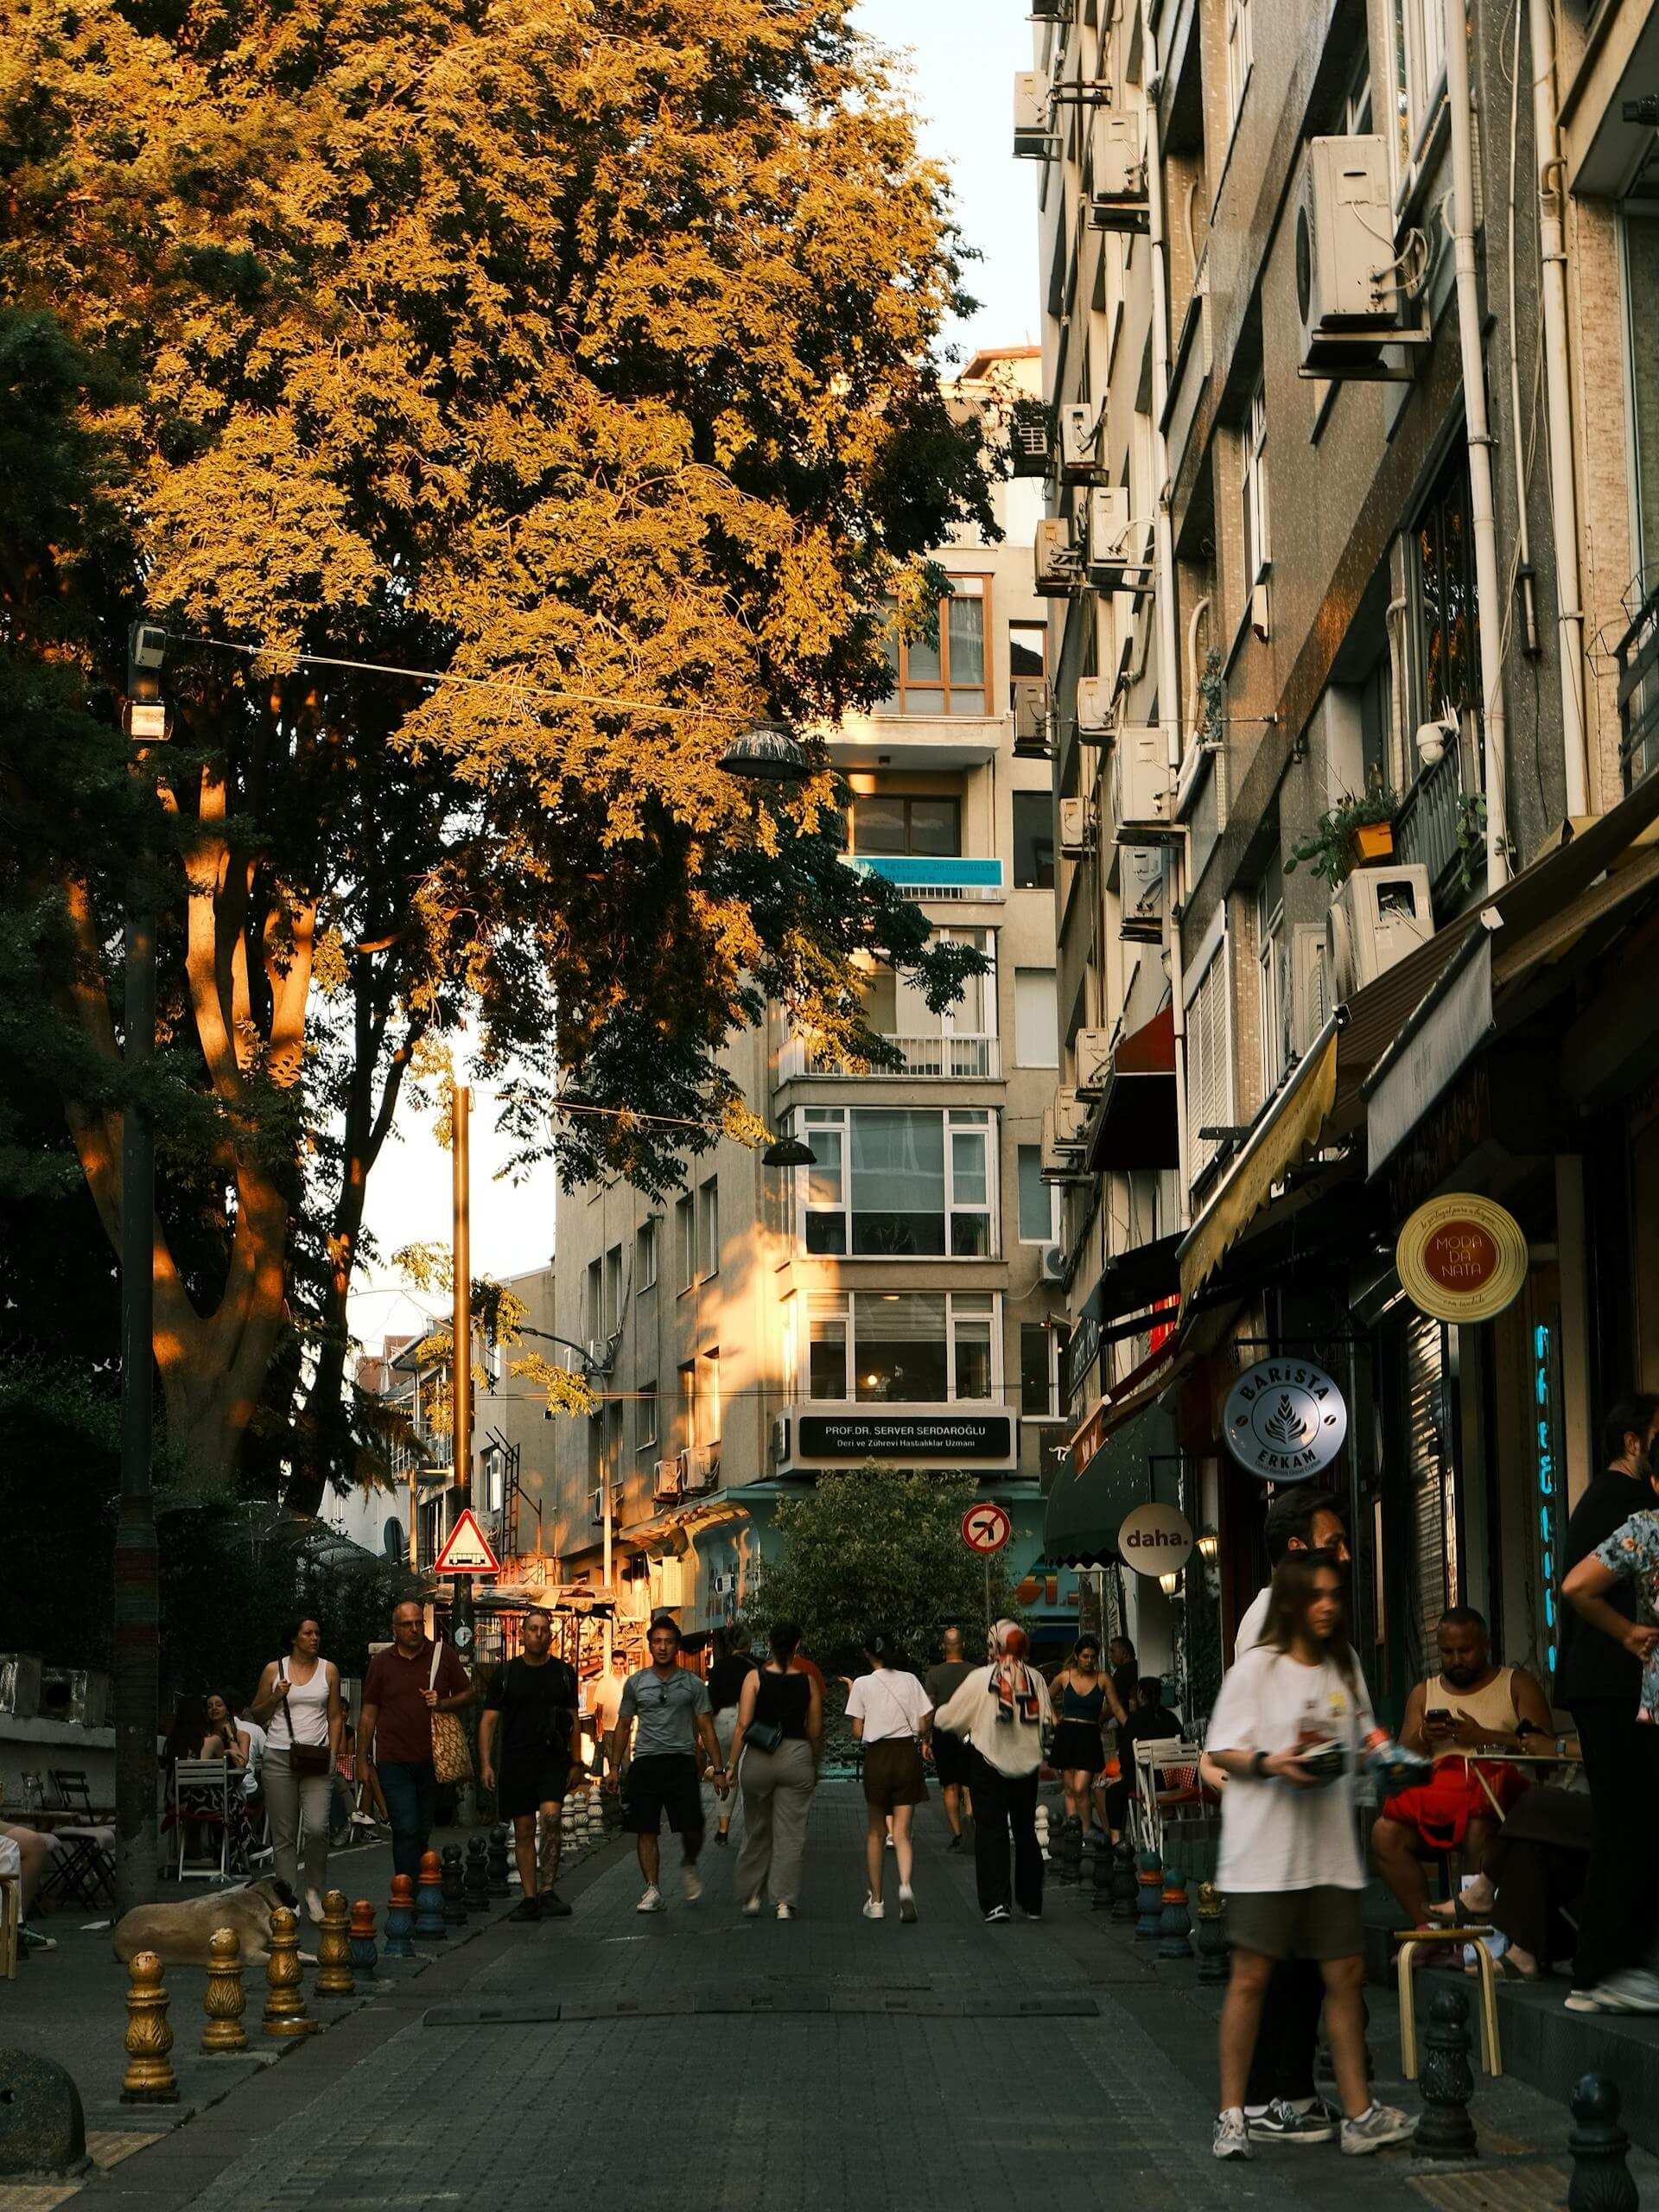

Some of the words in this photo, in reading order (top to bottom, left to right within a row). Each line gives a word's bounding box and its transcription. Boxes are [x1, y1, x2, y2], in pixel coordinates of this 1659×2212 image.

[1436, 1235, 1483, 1250] MODA
[1449, 1250, 1471, 1263] DA
[1441, 1262, 1482, 1277] NATA
[874, 1426, 914, 1435] SERVER
[916, 1423, 986, 1435] SERDAROĞLU
[836, 1439, 855, 1447] Deri
[868, 1439, 898, 1447] Zührevi
[945, 1439, 976, 1447] Uzmanı
[1258, 1449, 1316, 1468] ERKAM
[1126, 1529, 1189, 1548] daha.
